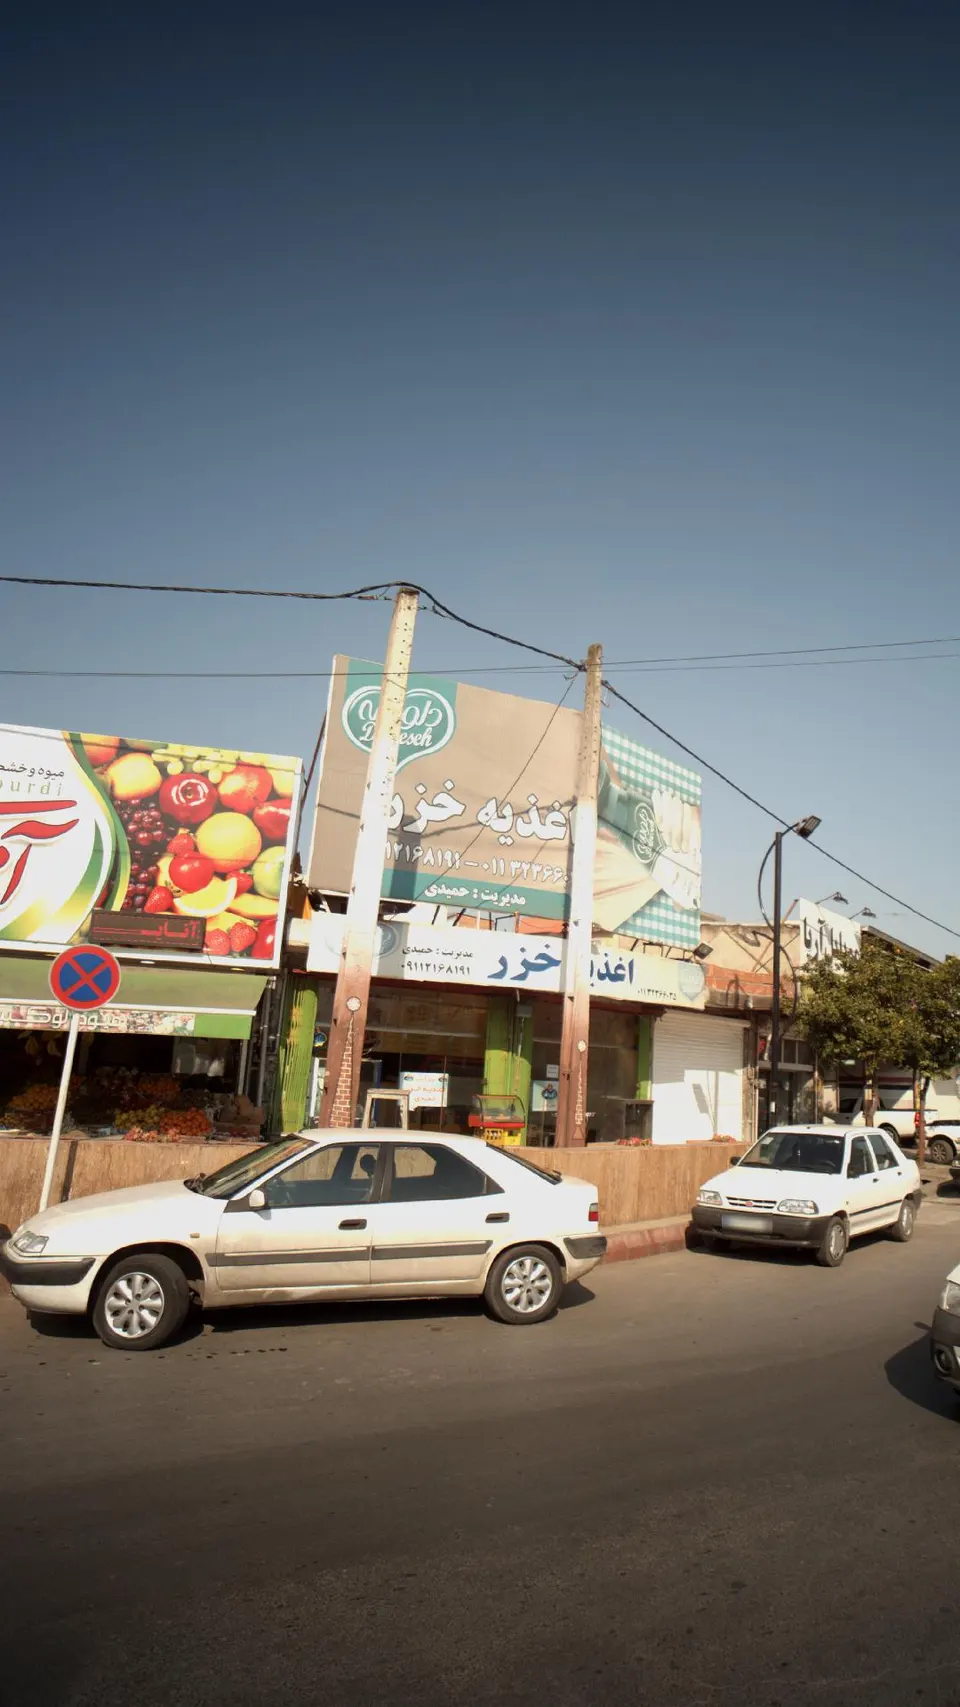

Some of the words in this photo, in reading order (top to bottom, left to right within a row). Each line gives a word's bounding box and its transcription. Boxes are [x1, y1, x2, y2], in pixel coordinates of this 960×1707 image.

[27, 767, 36, 777] و
[38, 767, 65, 780] میوه
[383, 840, 461, 871] ۱۲۱۶۸۱۹۱
[509, 860, 570, 885] ۳۲۳۶۶۰
[424, 883, 470, 899] حمیدی
[487, 943, 562, 981] خزر
[589, 952, 635, 988] اغذ
